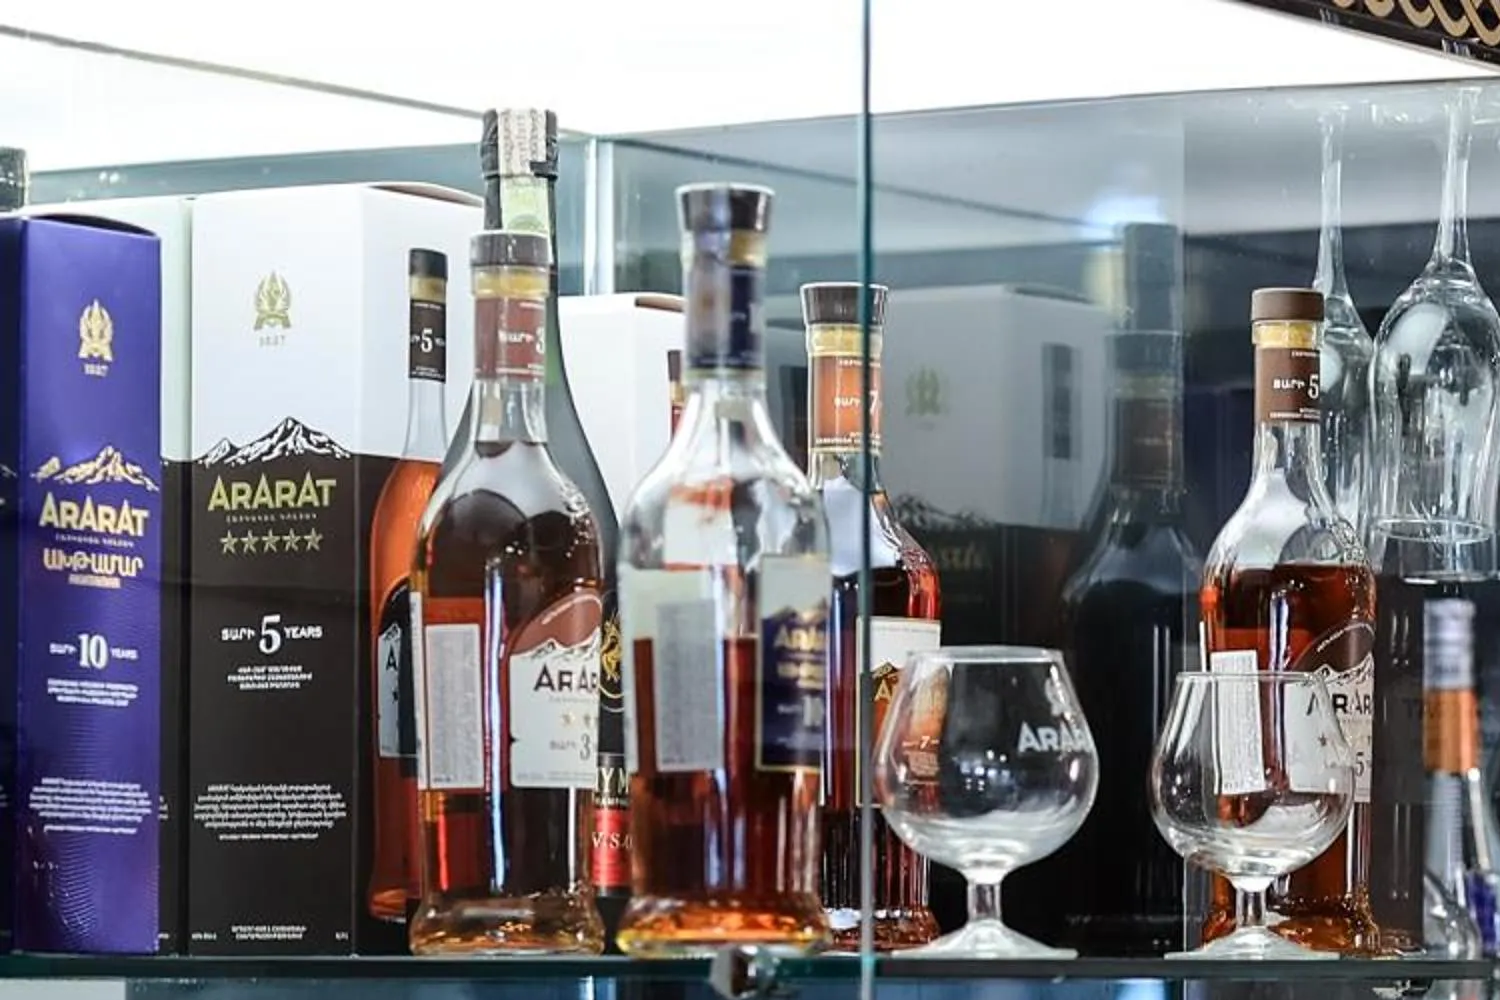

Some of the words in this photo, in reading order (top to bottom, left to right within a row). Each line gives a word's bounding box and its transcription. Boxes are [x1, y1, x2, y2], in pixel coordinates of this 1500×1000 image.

[207, 470, 337, 512] ARARAT
[38, 491, 150, 537] ARARAT
[78, 633, 108, 670] 10
[259, 614, 281, 654] 5
[283, 626, 323, 639] YEARS
